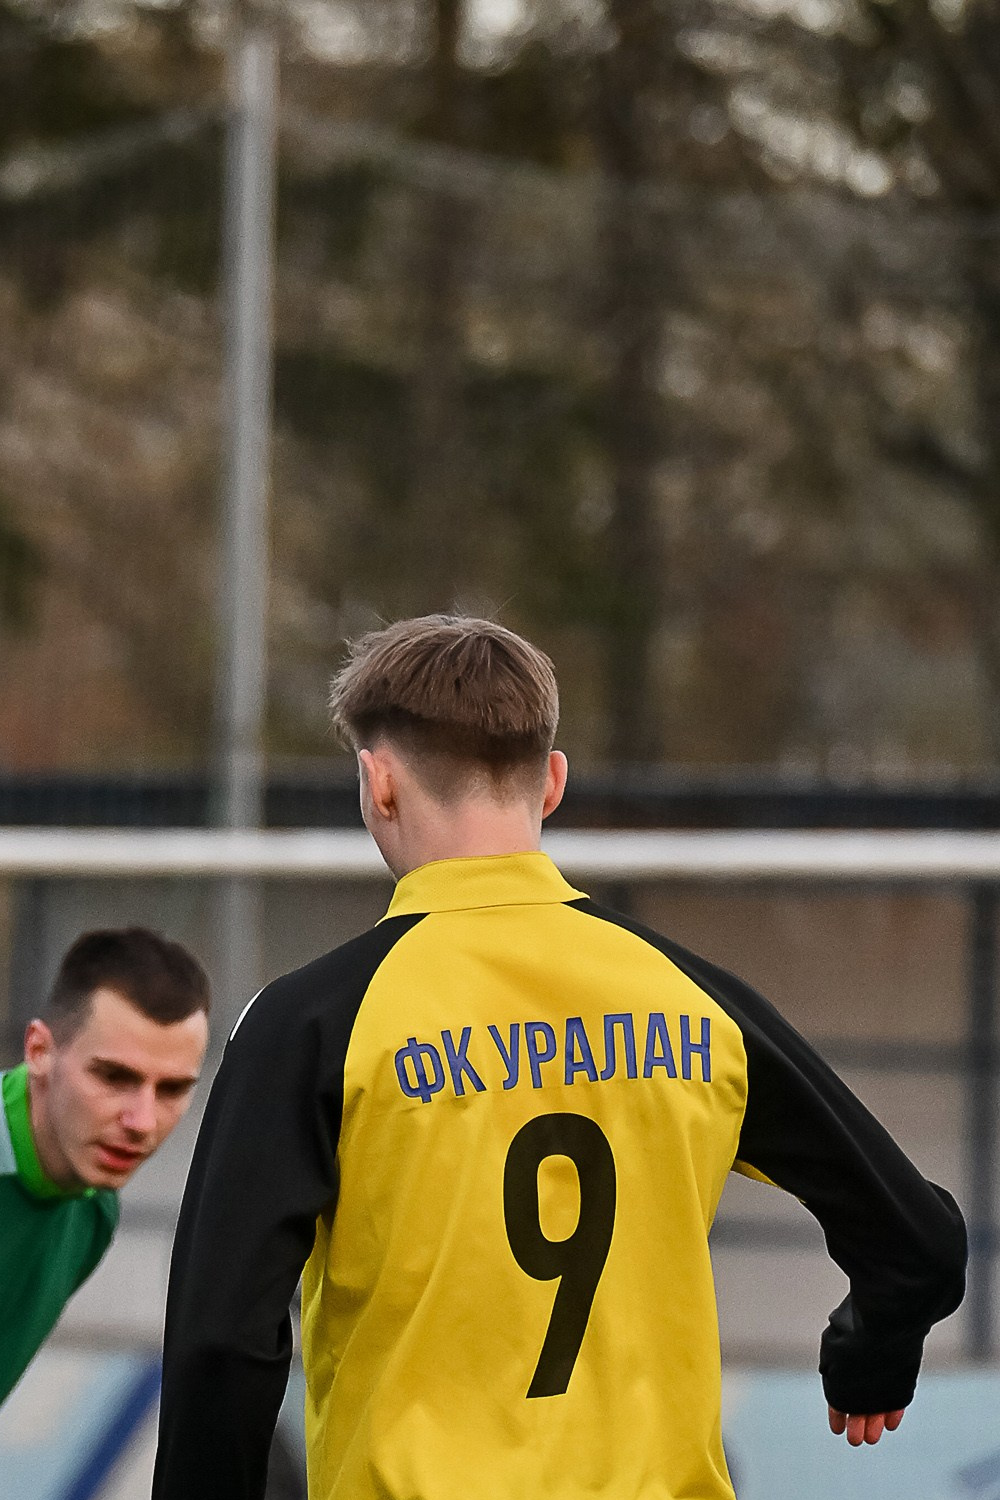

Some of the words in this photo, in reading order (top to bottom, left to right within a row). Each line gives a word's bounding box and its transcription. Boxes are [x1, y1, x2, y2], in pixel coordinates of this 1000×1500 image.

[394, 1026, 486, 1104] ФК
[487, 1012, 711, 1091] УРАЛАН
[503, 1111, 617, 1399] 9
